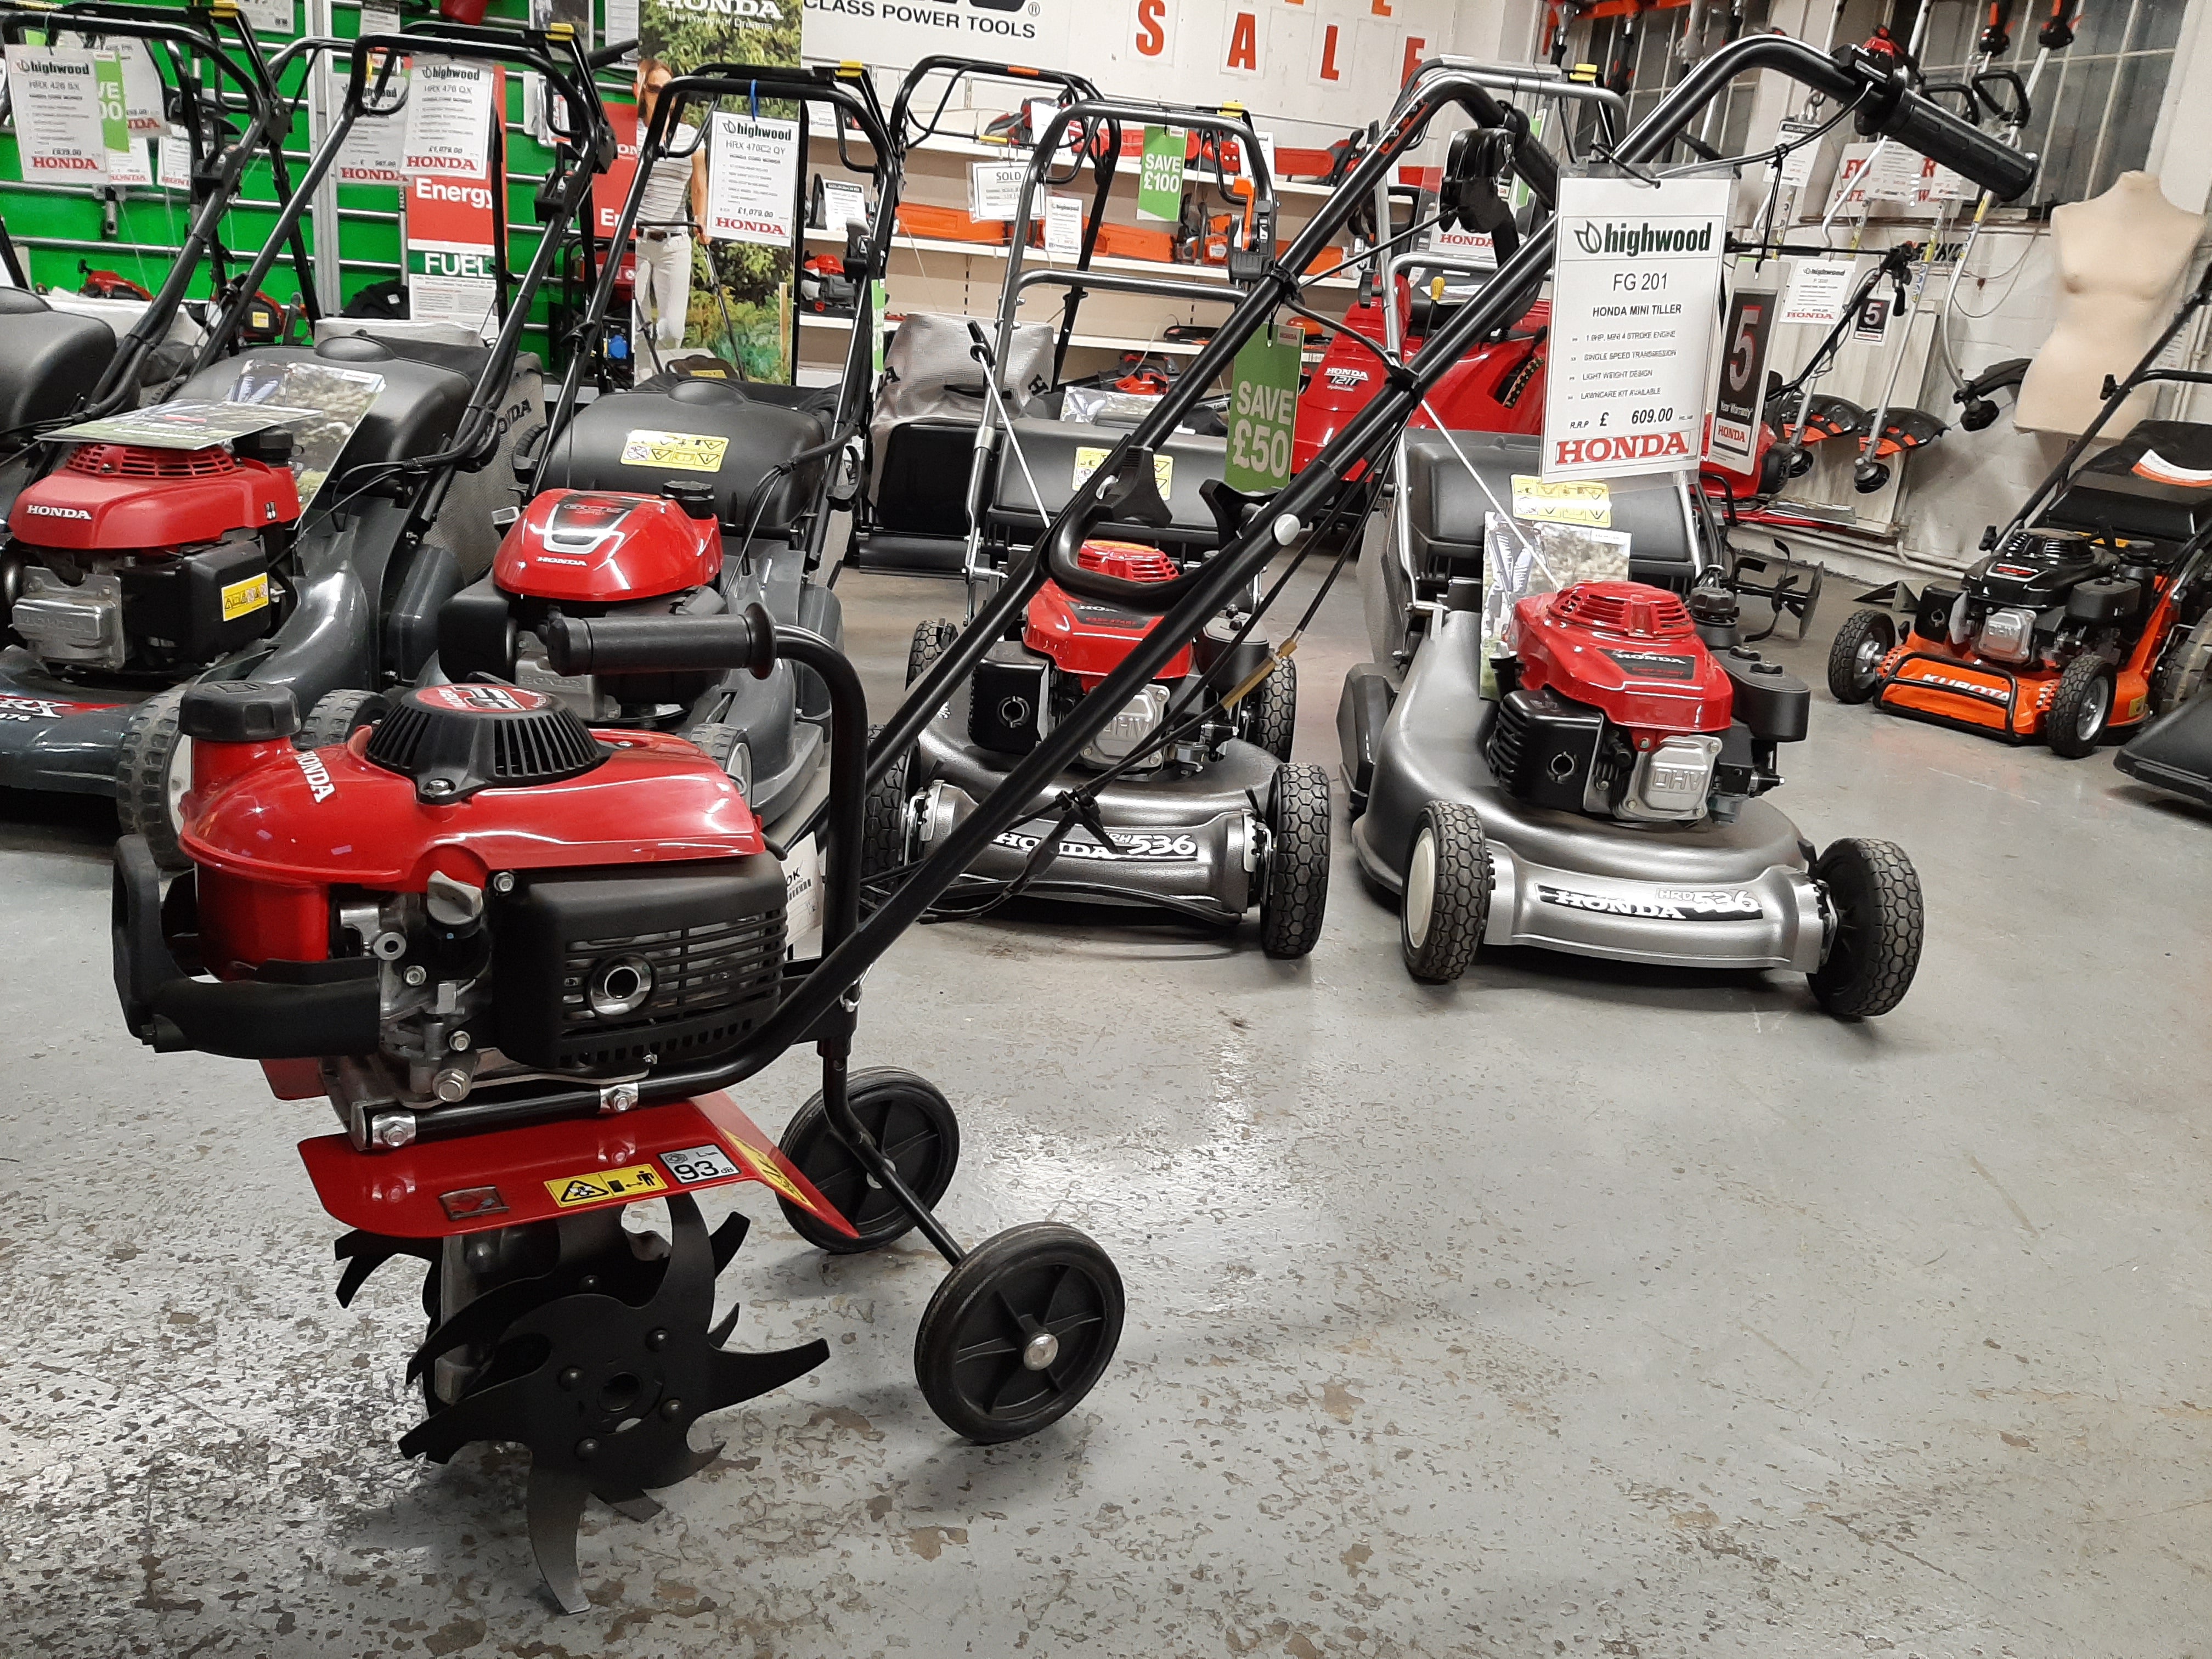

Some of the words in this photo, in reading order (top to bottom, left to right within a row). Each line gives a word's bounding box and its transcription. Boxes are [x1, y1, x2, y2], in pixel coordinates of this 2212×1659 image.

[882, 4, 960, 29] POWER
[967, 15, 1036, 38] TOOLS
[31, 60, 89, 75] highwood
[433, 66, 480, 81] highwood
[737, 122, 792, 141] highwood
[32, 156, 98, 170] HONDA
[407, 156, 477, 171] HONDA
[1145, 154, 1182, 172] SAVE
[996, 172, 1022, 181] SOLD
[1144, 171, 1180, 193] £100
[415, 177, 493, 209] Energy
[715, 217, 786, 235] HONDA
[1604, 222, 1712, 257] highwood
[425, 253, 494, 278] FUEL
[1613, 273, 1636, 291] FG
[1641, 273, 1667, 291] 201
[1593, 306, 1627, 317] HONDA
[1630, 305, 1649, 315] MINI
[1652, 304, 1681, 314] TILLER
[1864, 302, 1883, 325] 5
[1279, 332, 1298, 341] HONDA
[1584, 353, 1608, 361] SINGLE
[1609, 351, 1630, 360] SPEED
[1730, 305, 1763, 392] 5
[1325, 368, 1368, 381] HONDA
[1603, 371, 1628, 379] WEIGHT
[1629, 369, 1652, 377] DESIGN
[1629, 387, 1661, 396] AVAILABLE
[1237, 381, 1294, 425] SAVE
[498, 397, 532, 434] ONDA
[1599, 412, 1609, 426] £
[1632, 408, 1673, 425] 609.00
[1718, 425, 1746, 443] HONDA
[1233, 419, 1288, 478] £50
[1556, 432, 1689, 465] HONDA
[27, 505, 92, 520] HONDA
[536, 556, 588, 566] HONDA
[1923, 674, 2011, 702] KUBOTA
[294, 751, 336, 803] HONDA
[1127, 834, 1195, 855] 536
[1555, 891, 1686, 919] HONDA
[1694, 891, 1759, 913] 536
[674, 1160, 719, 1180] 93
